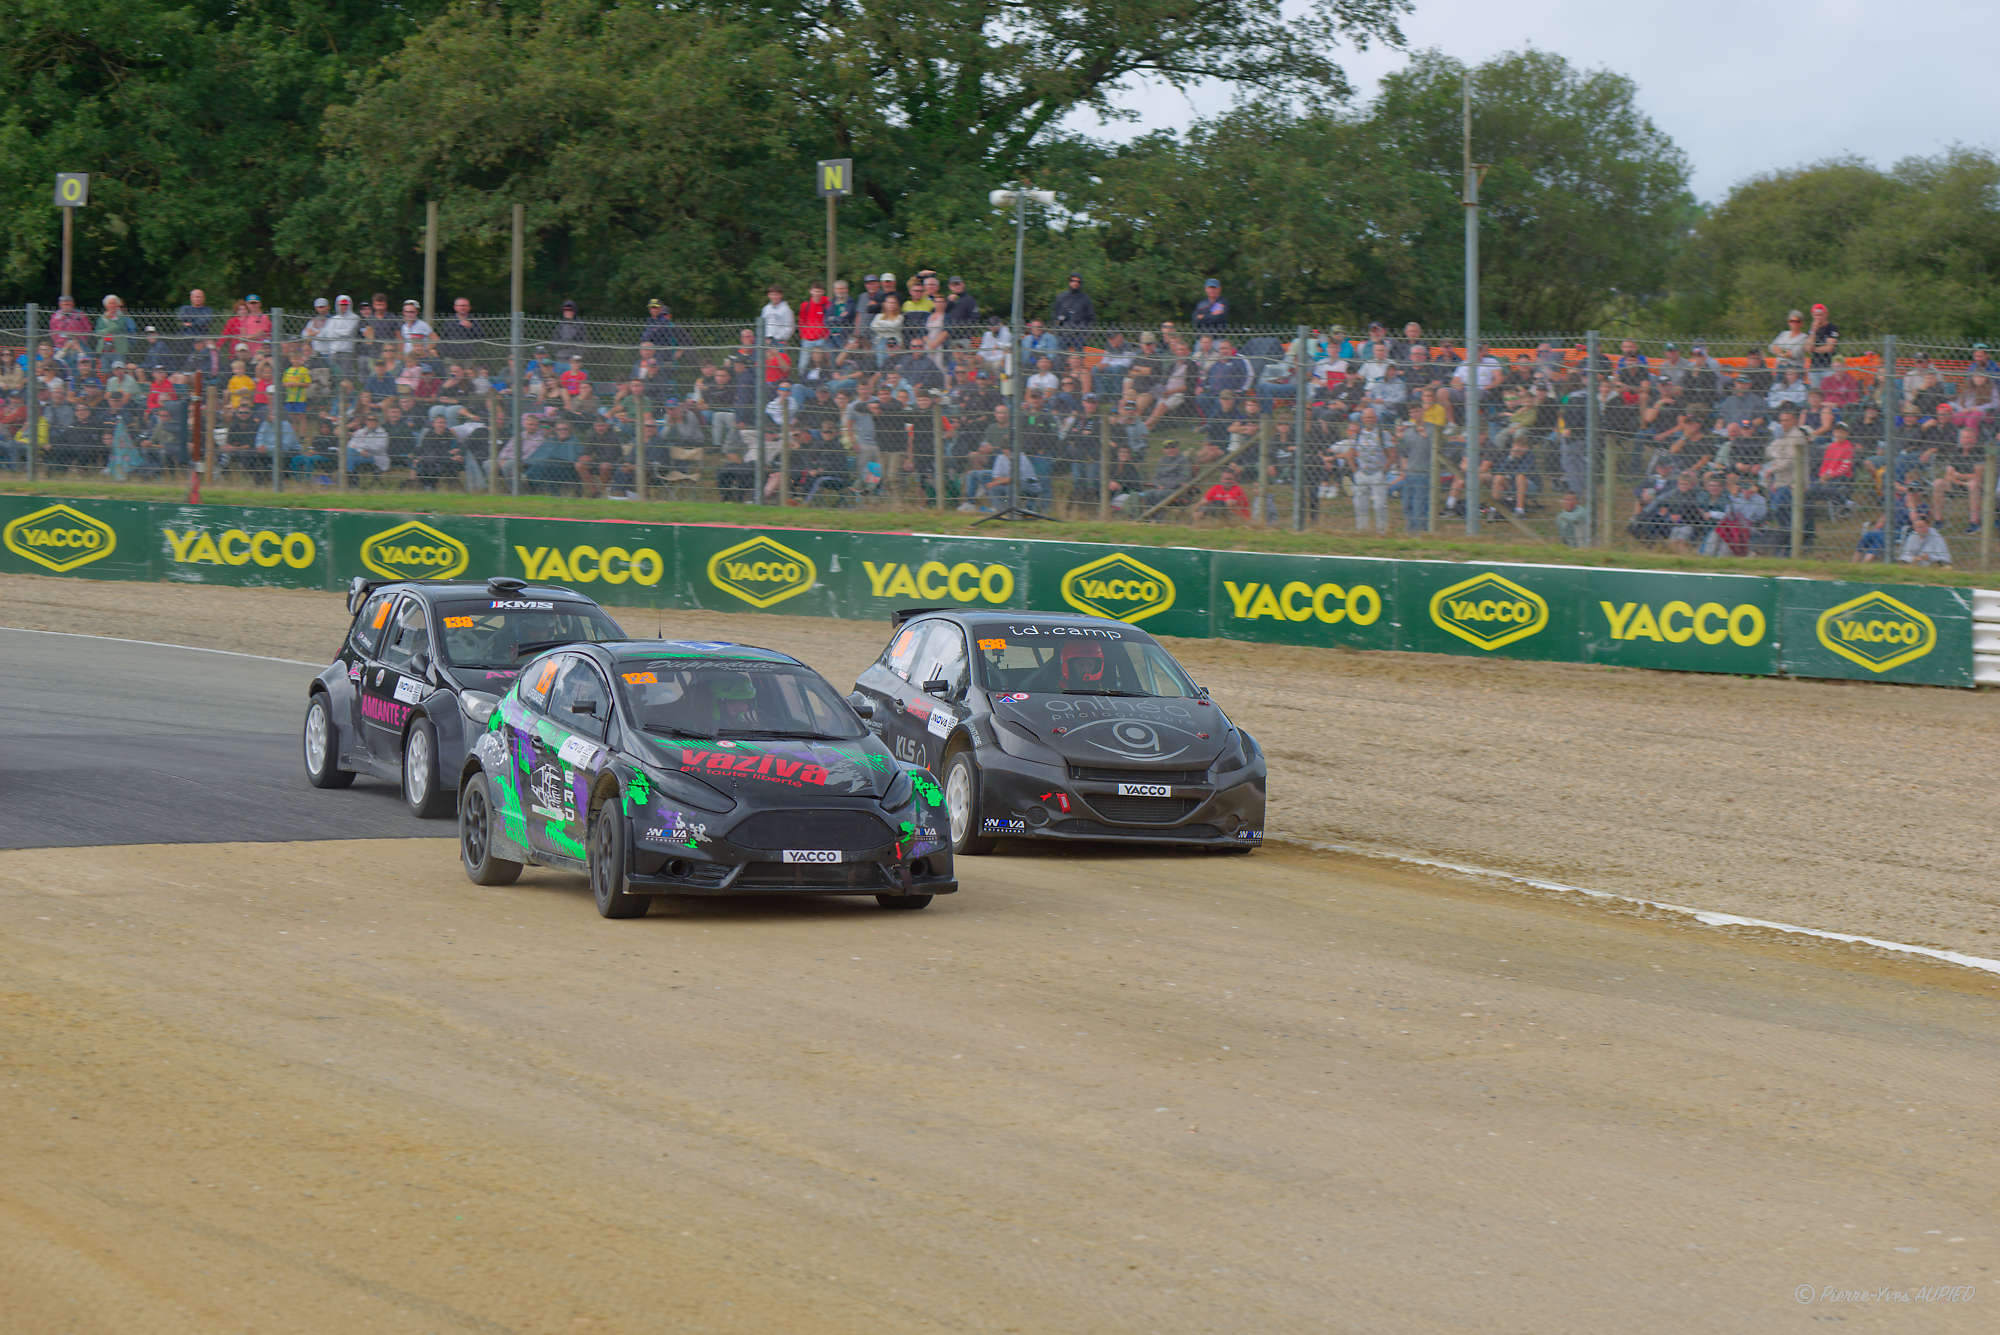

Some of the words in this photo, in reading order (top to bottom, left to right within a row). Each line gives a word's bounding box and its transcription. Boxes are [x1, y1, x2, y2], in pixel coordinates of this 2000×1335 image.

[824, 165, 843, 190] N
[22, 527, 101, 550] YACCO
[163, 529, 316, 569] YACCO
[377, 545, 455, 567] YACCO
[515, 545, 664, 586] YACCO
[724, 560, 800, 583] YACCO
[862, 561, 1014, 604] YACCO
[1079, 577, 1159, 602] YACCO
[1223, 580, 1382, 626] YACCO
[1448, 599, 1532, 624] YACCO
[1599, 600, 1766, 647] YACCO
[1835, 619, 1920, 645] YACCO
[977, 638, 1007, 650] 198
[622, 672, 658, 685] 123
[680, 765, 701, 773] en
[706, 769, 748, 778] toute
[681, 749, 830, 786] vaziva
[1124, 785, 1167, 796] YACCO
[789, 850, 837, 862] YACCO
